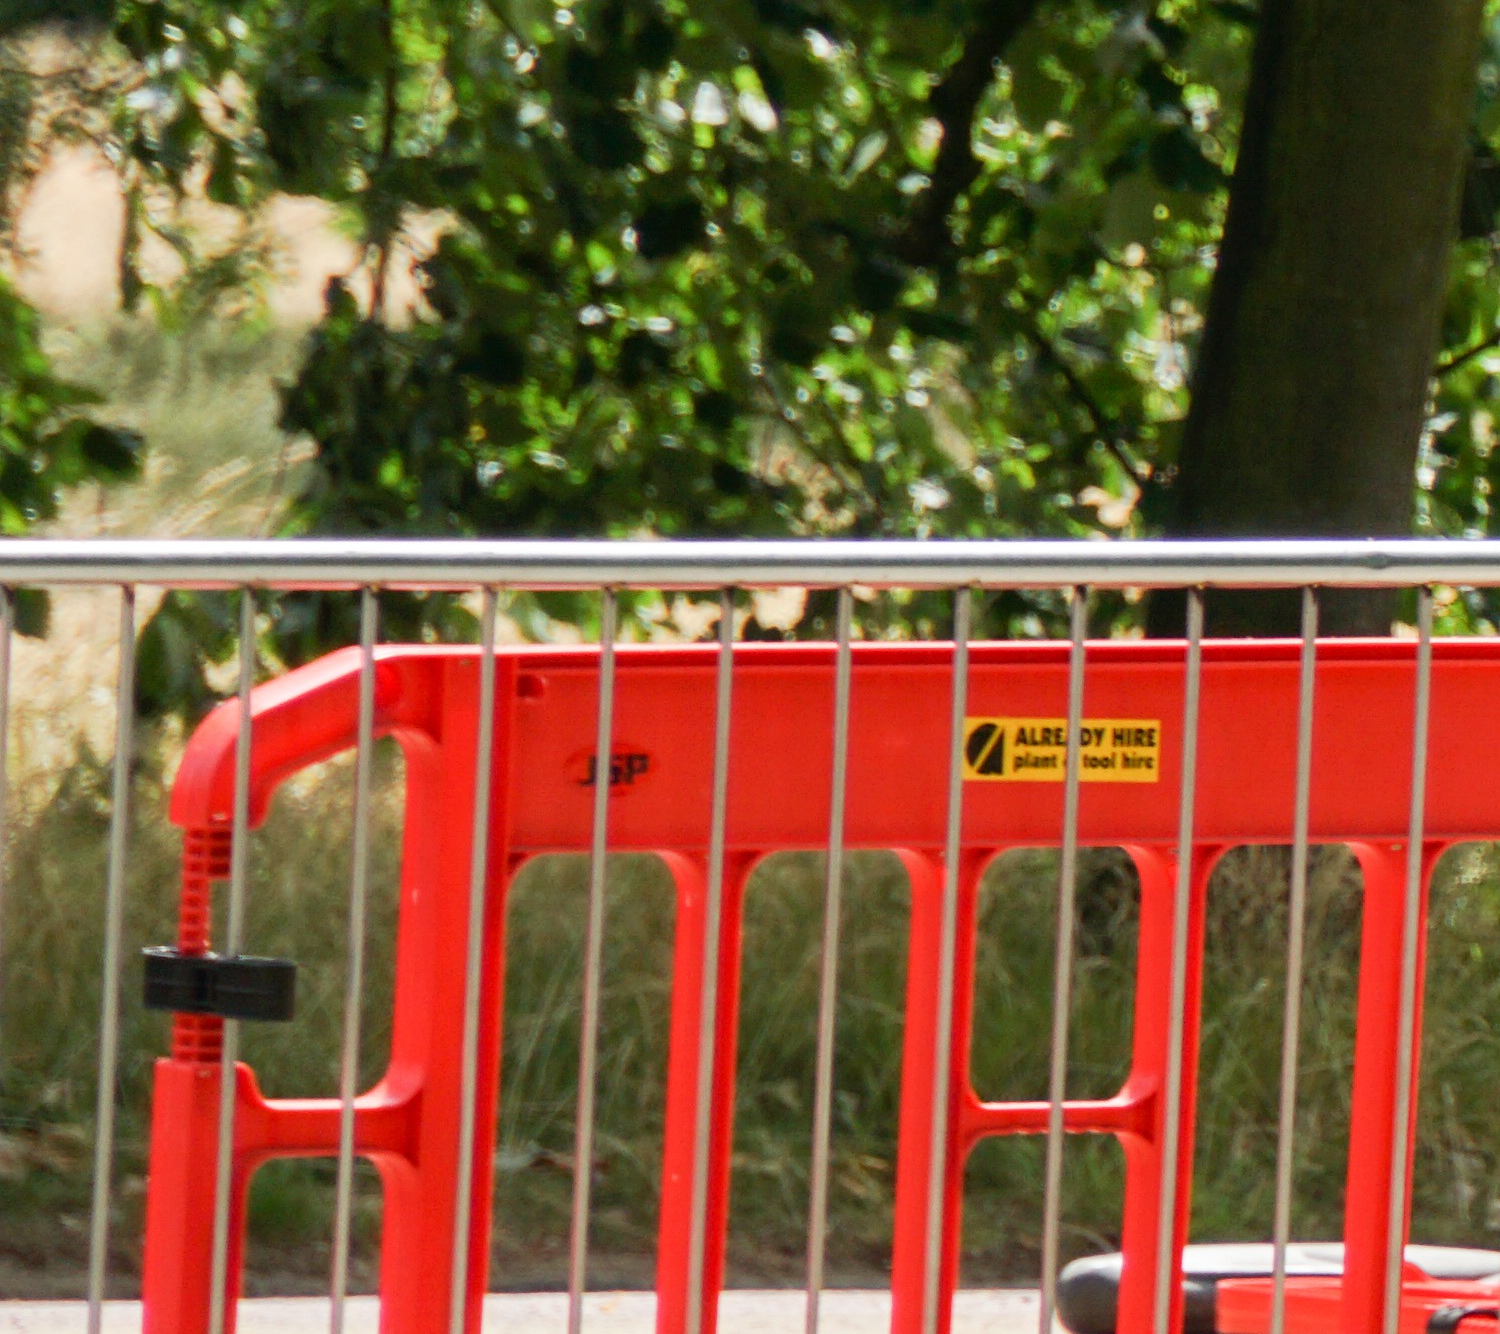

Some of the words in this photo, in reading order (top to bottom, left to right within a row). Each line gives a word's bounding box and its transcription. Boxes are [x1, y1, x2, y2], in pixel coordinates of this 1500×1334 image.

[1015, 726, 1105, 747] ALREDY
[1112, 727, 1157, 748] HIRE
[1013, 750, 1058, 773] plant
[1083, 752, 1116, 770] tool
[1121, 750, 1154, 770] hire
